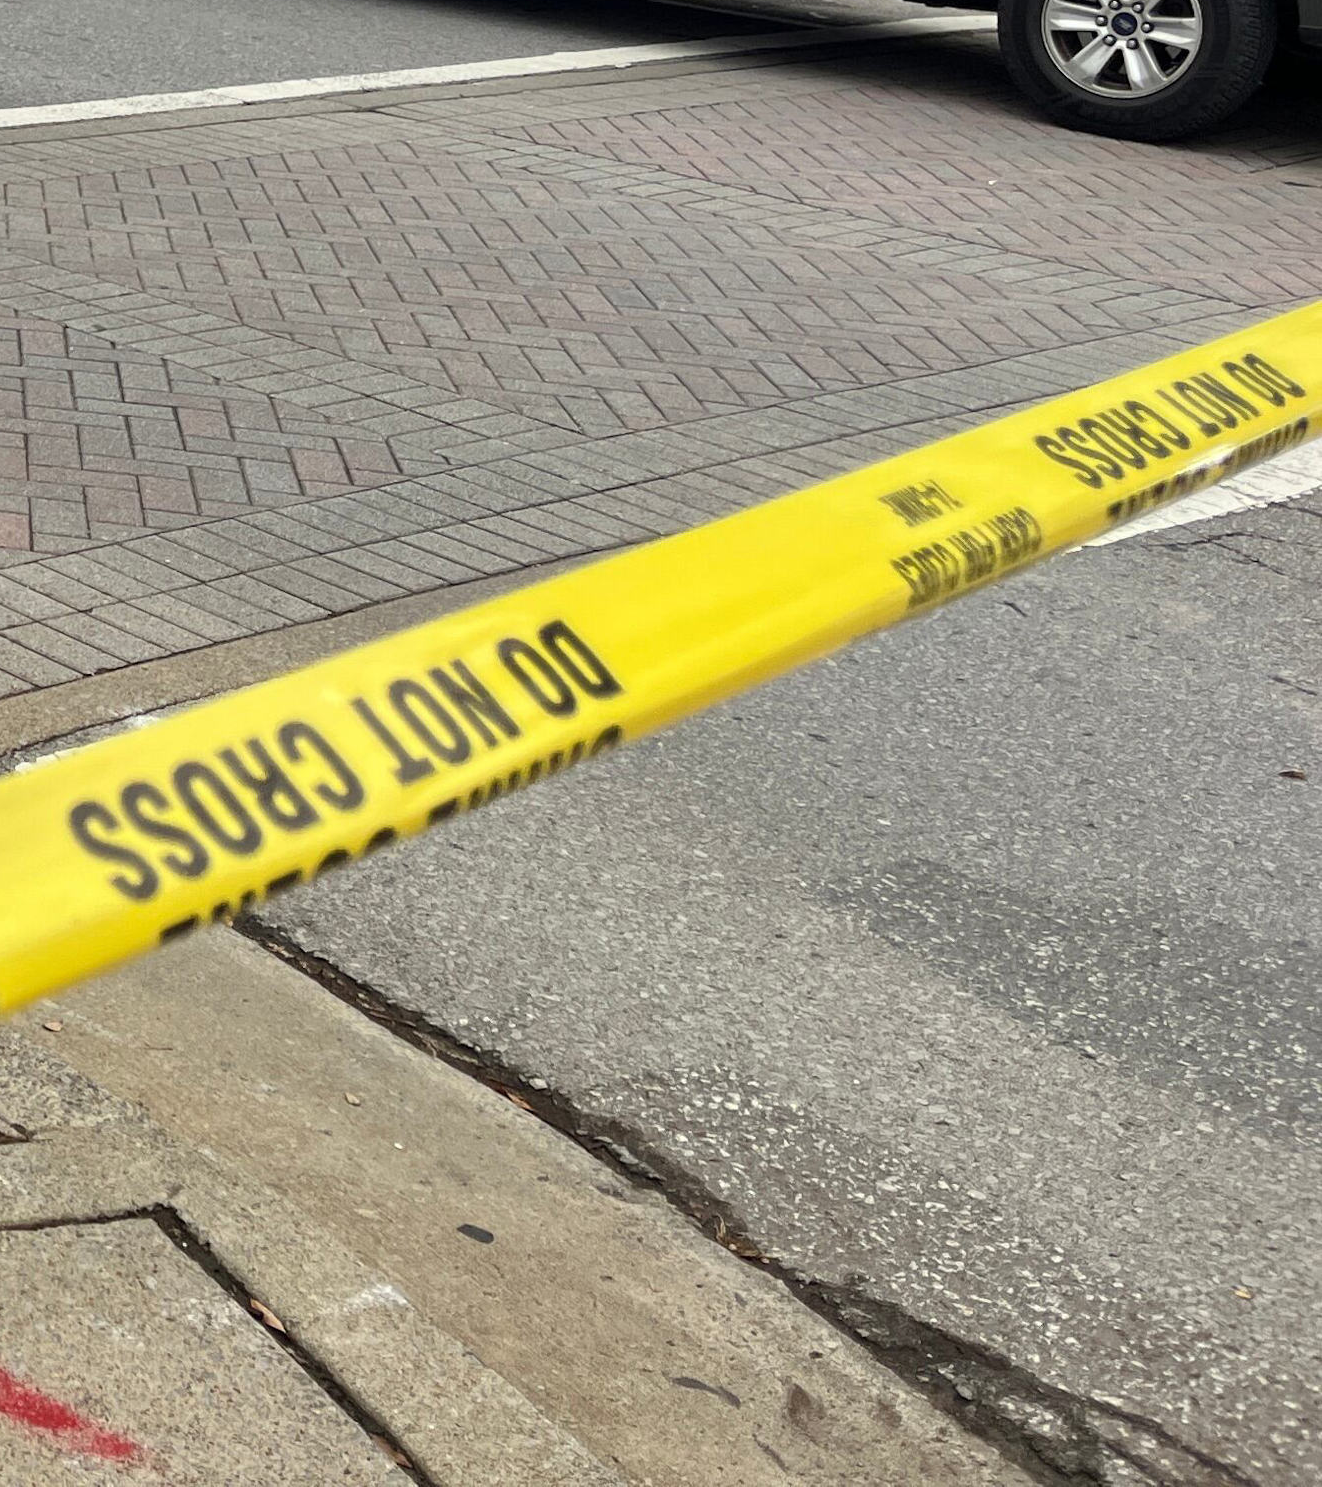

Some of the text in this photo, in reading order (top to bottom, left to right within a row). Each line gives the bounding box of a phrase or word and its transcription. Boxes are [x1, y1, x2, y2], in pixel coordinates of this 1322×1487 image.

[1155, 372, 1261, 438] NOT
[1223, 353, 1307, 407] DO
[1033, 400, 1192, 489] CROSS
[497, 619, 623, 718] DO
[351, 658, 522, 787] NOT
[68, 720, 365, 901] CROSS
